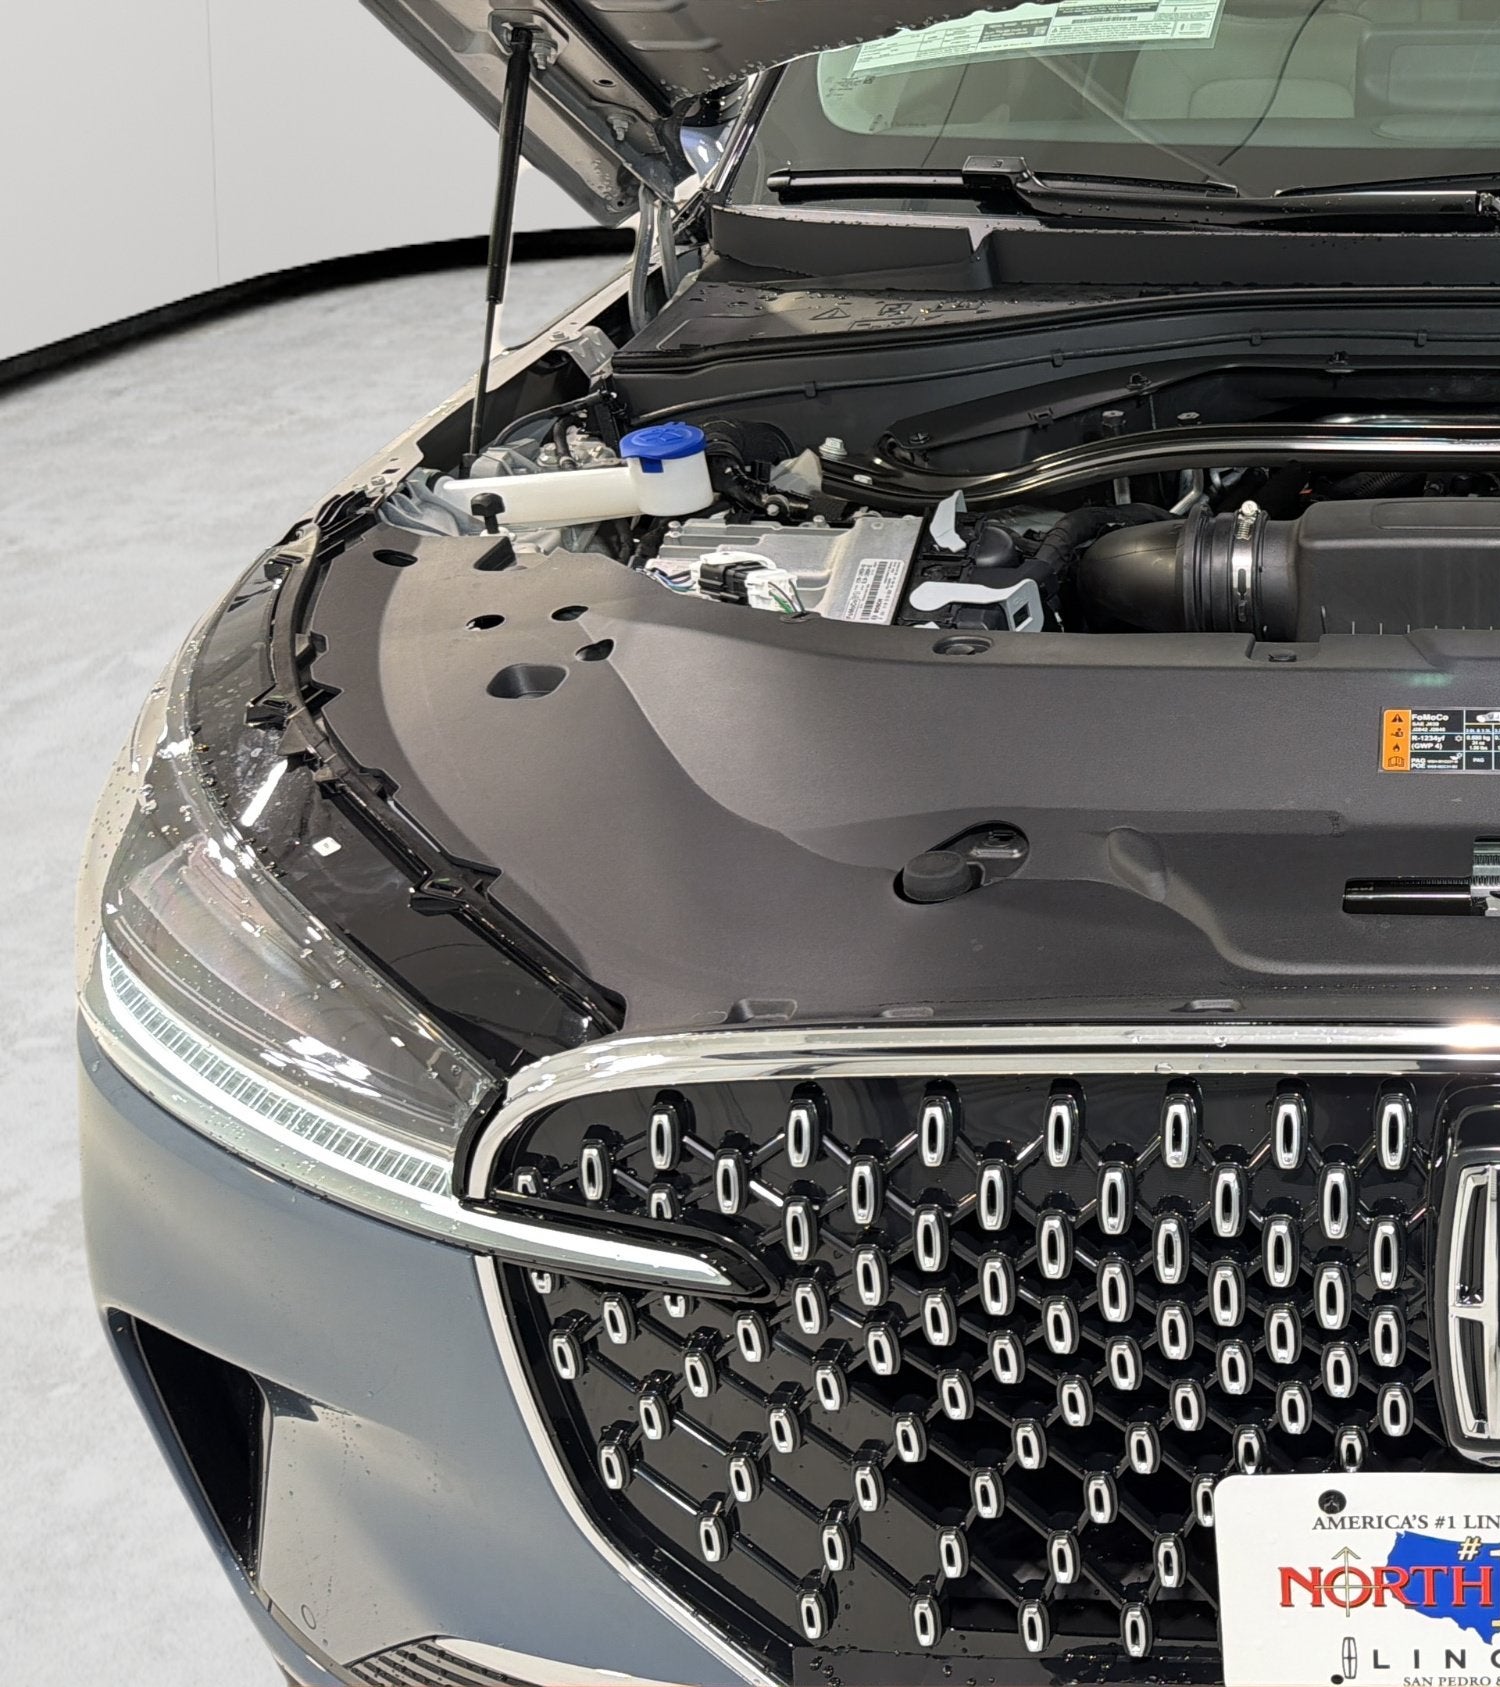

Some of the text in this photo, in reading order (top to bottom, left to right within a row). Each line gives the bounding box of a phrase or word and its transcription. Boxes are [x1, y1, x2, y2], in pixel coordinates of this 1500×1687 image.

[1312, 1514, 1428, 1530] AMERICA'S
[1435, 1515, 1455, 1529] #1
[1278, 1566, 1495, 1608] NORTH
[1403, 1676, 1433, 1687] SAN
[1438, 1676, 1491, 1687] PEDRO
